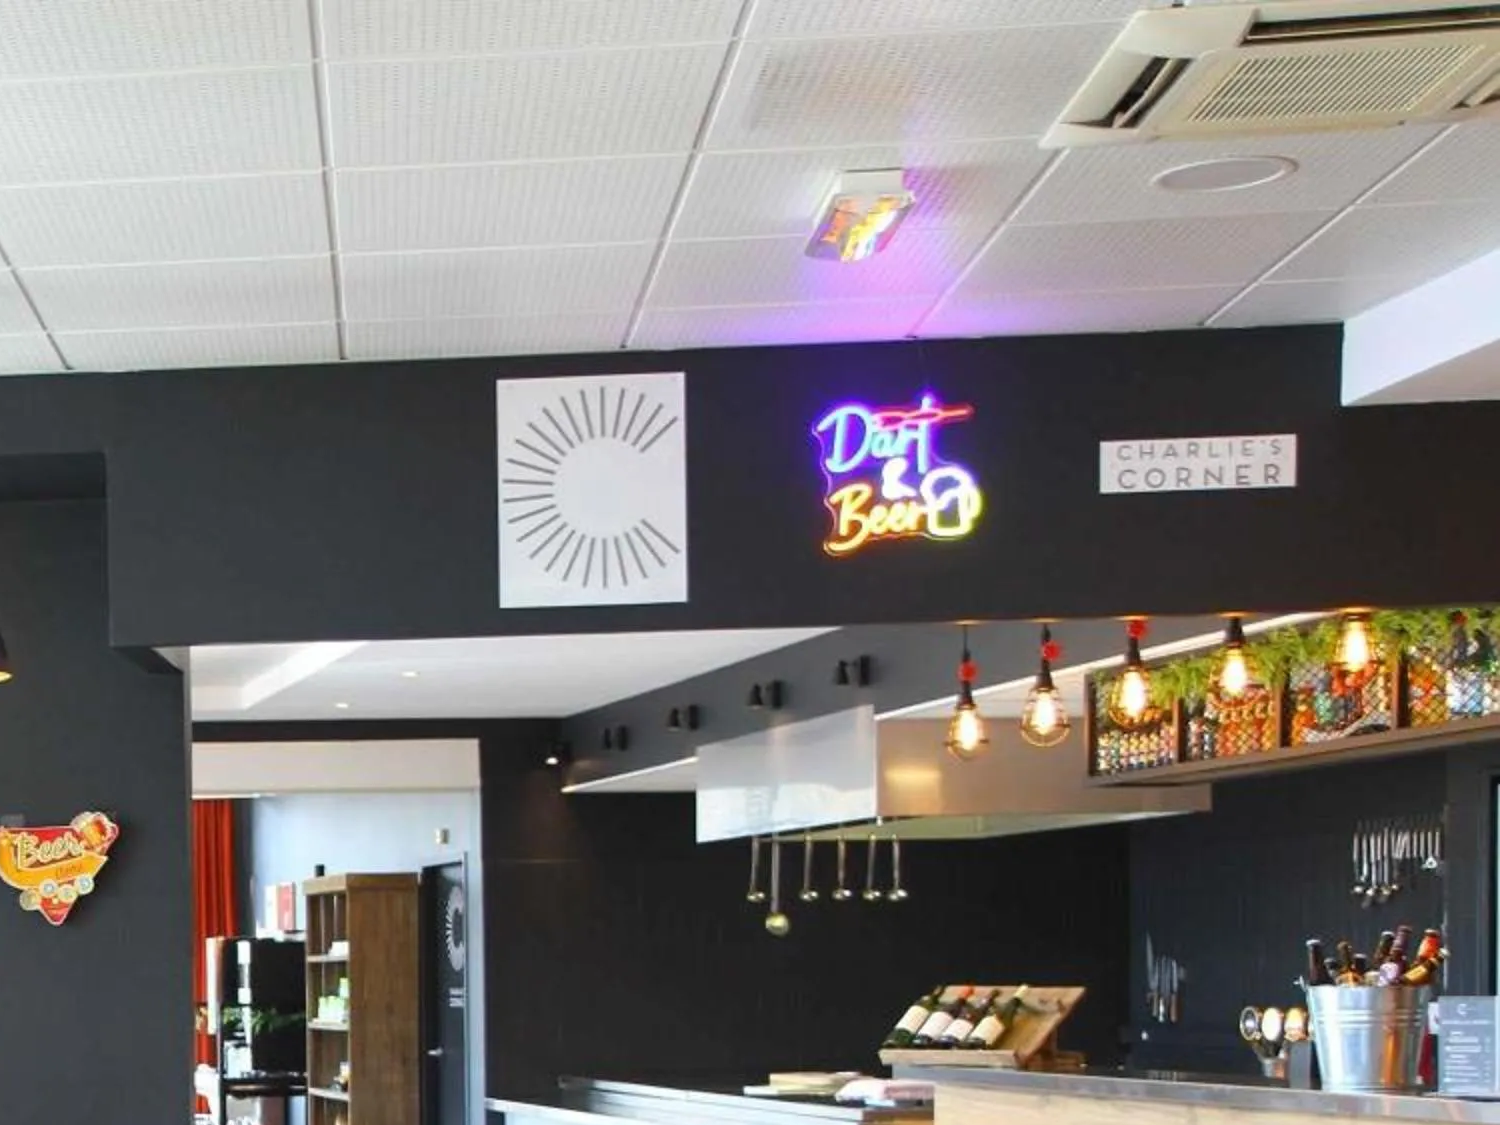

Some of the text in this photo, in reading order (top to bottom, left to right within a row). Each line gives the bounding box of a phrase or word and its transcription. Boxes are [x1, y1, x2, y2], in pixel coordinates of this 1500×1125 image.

[815, 395, 950, 474] Dart
[1116, 438, 1283, 461] CHARLIE'S
[1116, 463, 1281, 489] CORNER
[826, 482, 928, 553] Beer
